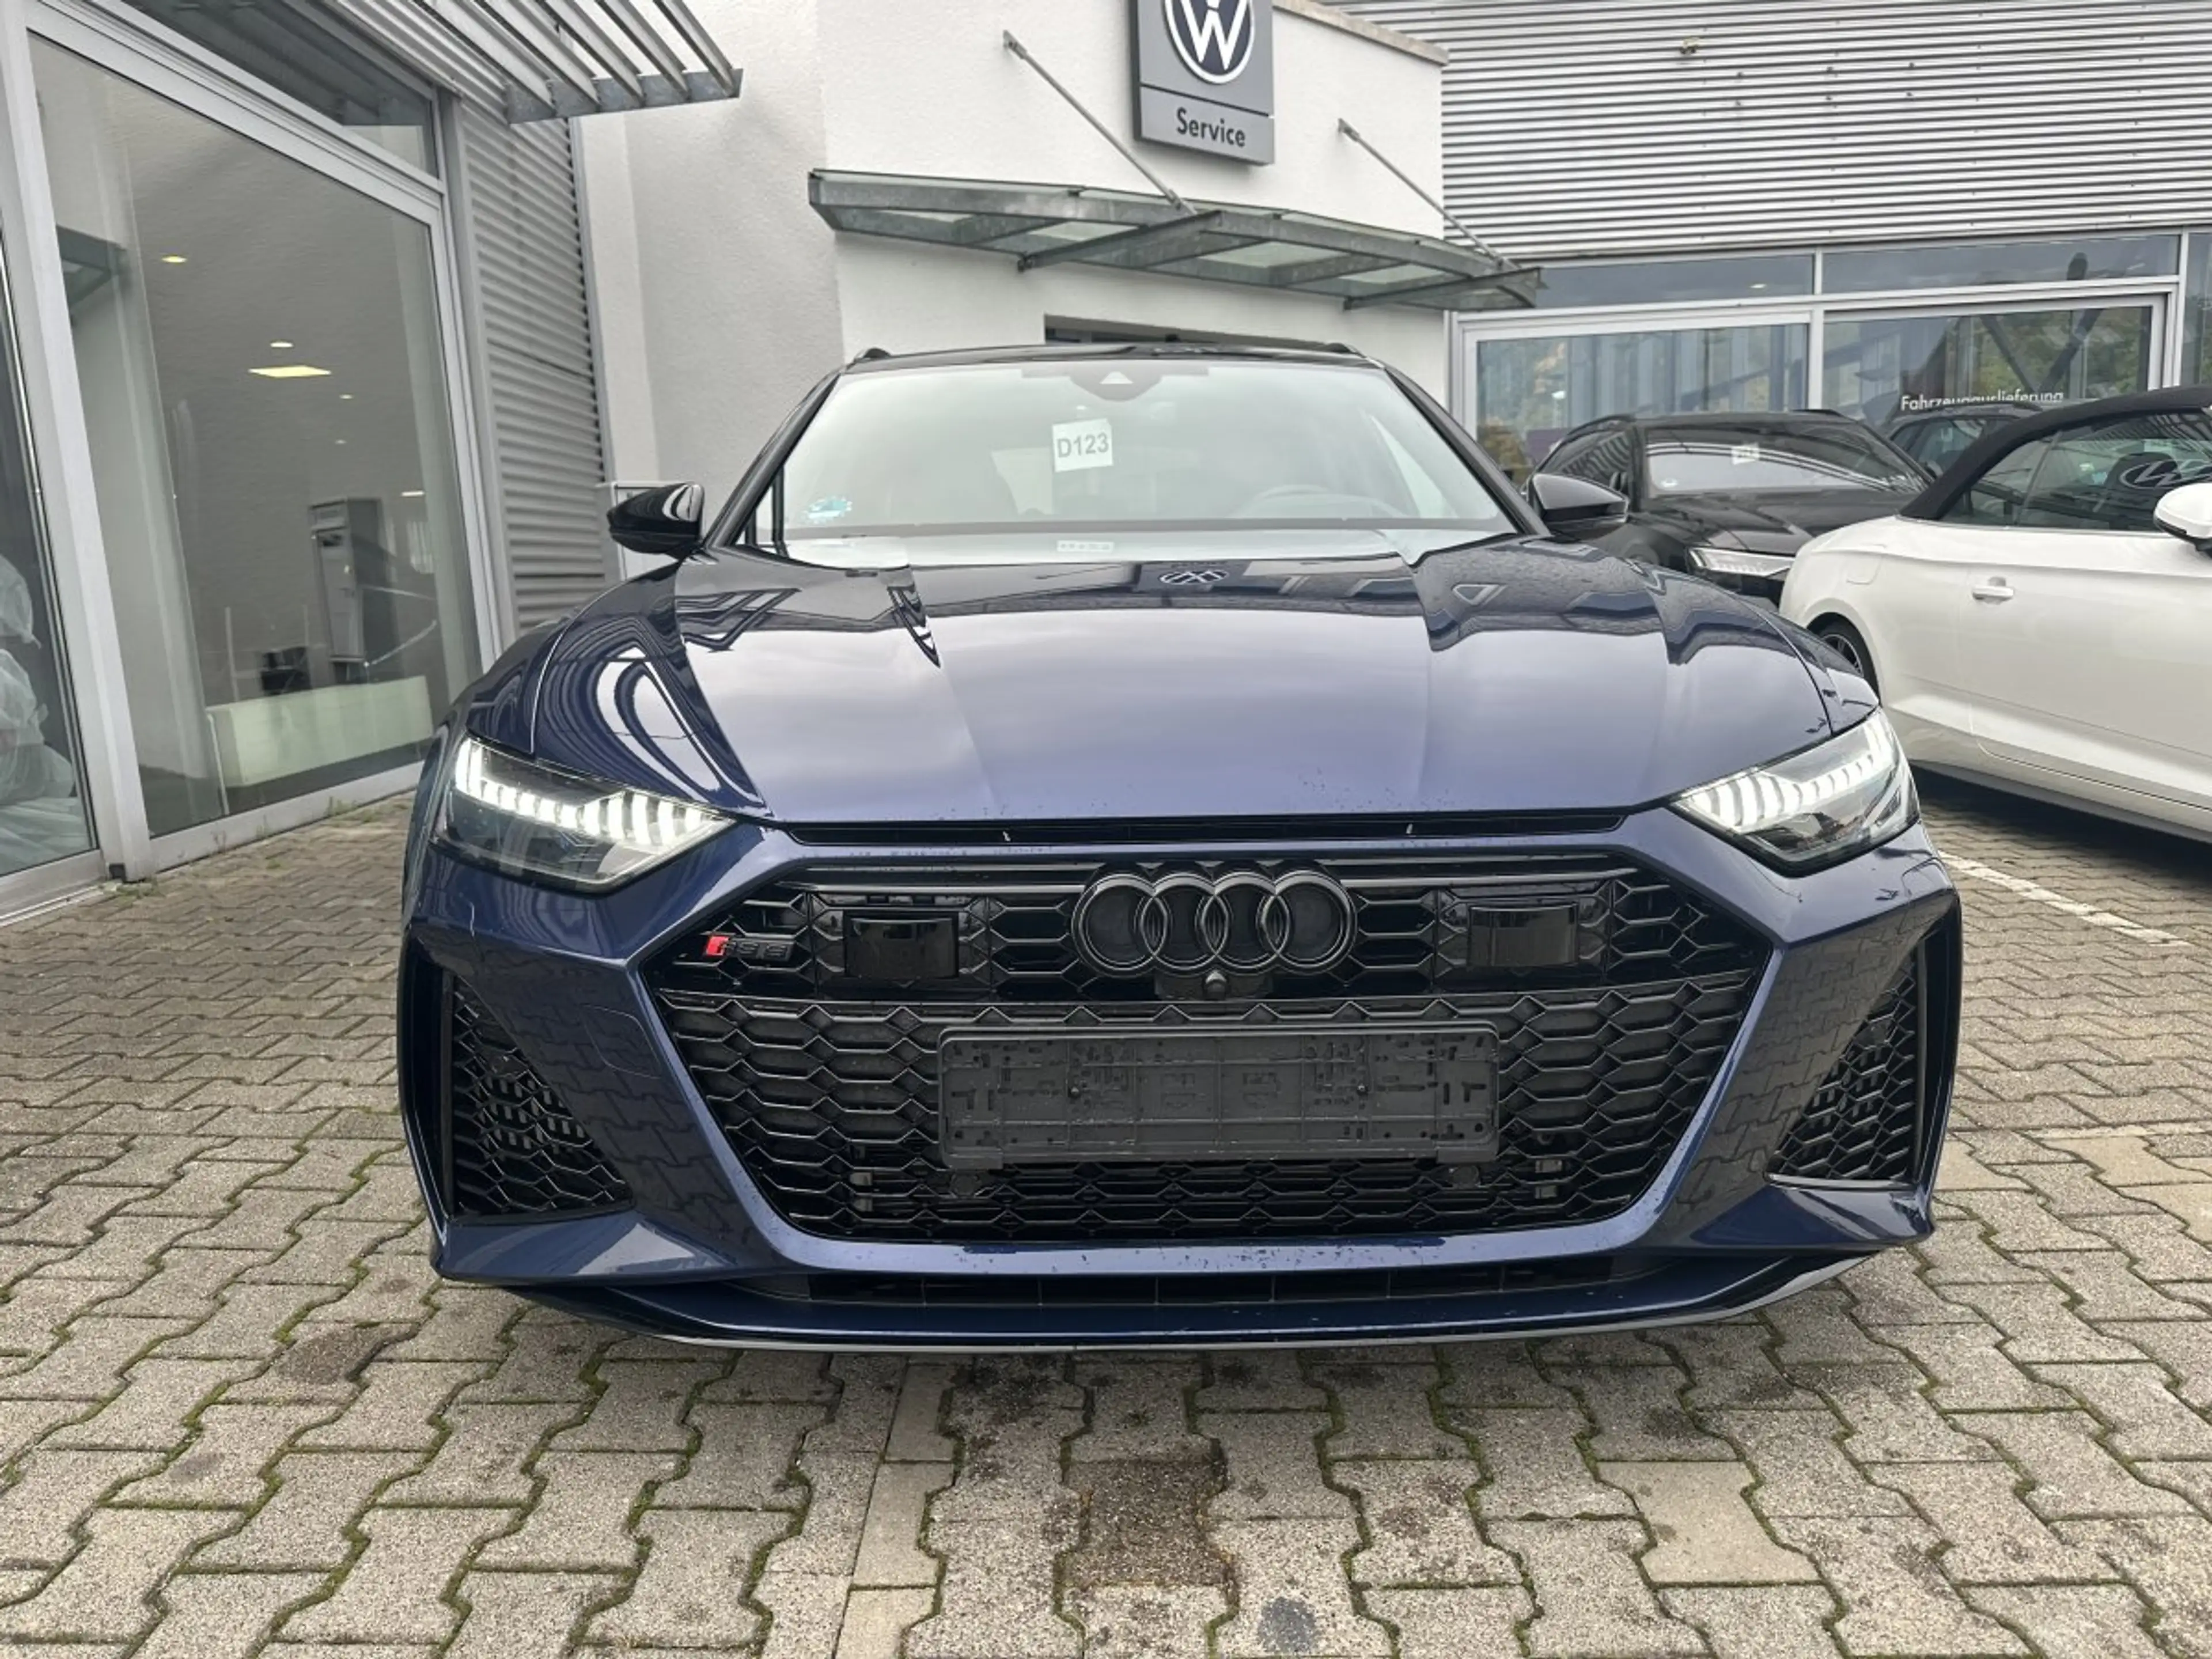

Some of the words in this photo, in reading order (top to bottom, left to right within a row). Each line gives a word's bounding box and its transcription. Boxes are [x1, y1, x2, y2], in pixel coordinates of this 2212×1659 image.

[1180, 0, 1248, 70] W
[1176, 107, 1245, 147] Service
[1056, 432, 1109, 458] D123
